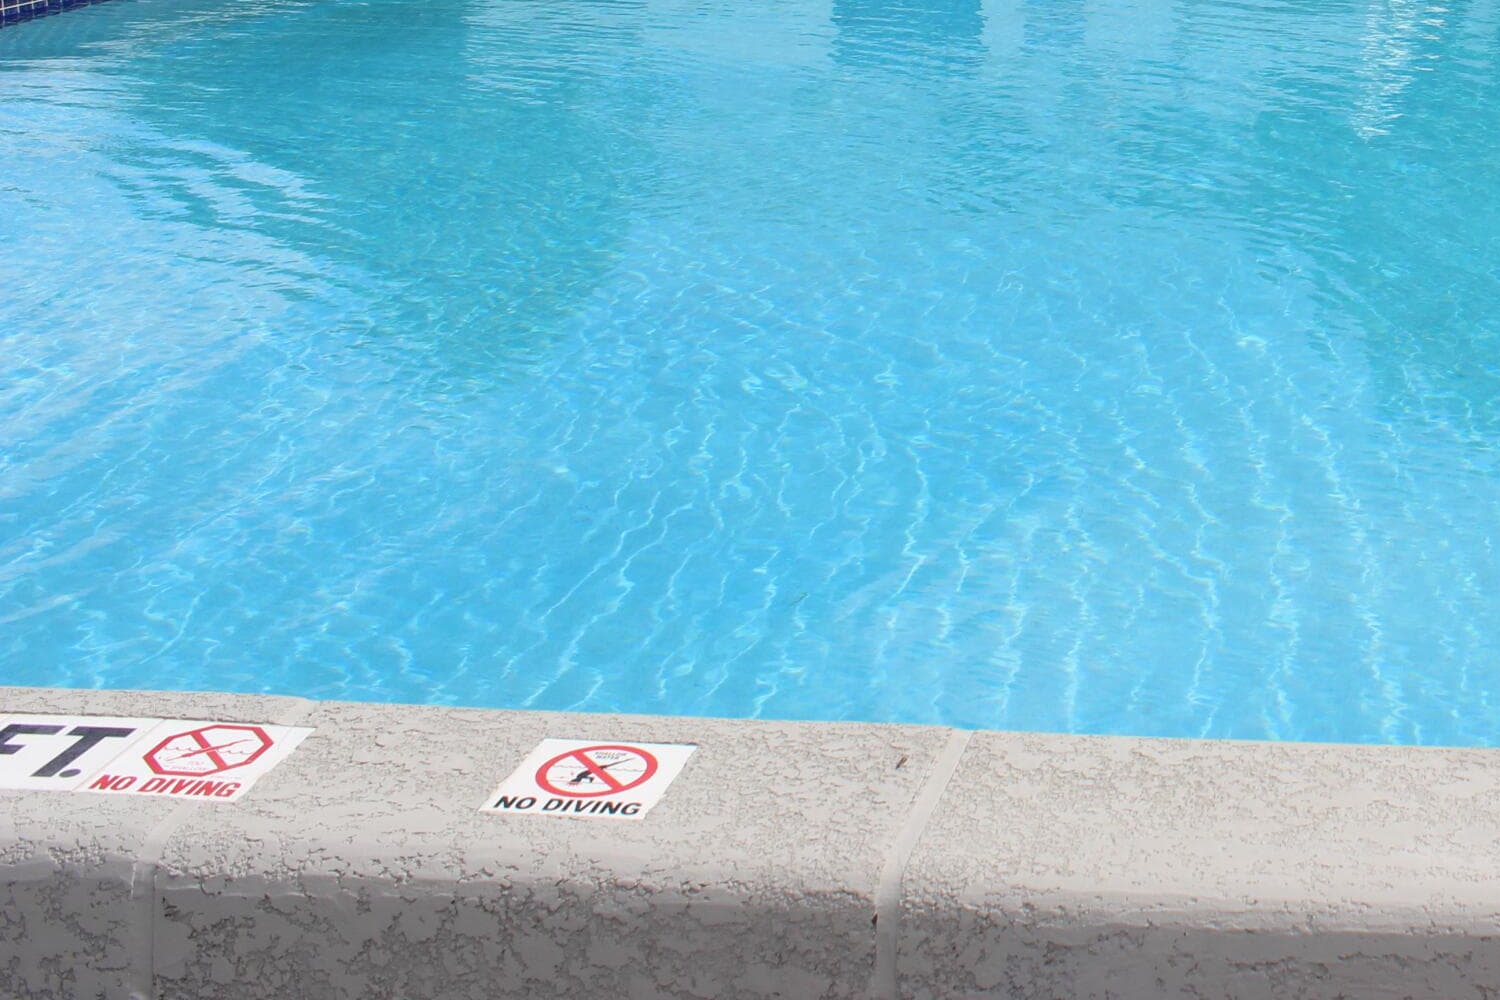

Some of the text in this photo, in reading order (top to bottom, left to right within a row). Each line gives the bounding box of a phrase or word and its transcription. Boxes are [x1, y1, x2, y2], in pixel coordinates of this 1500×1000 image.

[88, 774, 241, 798] NO DIVING
[493, 795, 642, 816] NO DIVING
